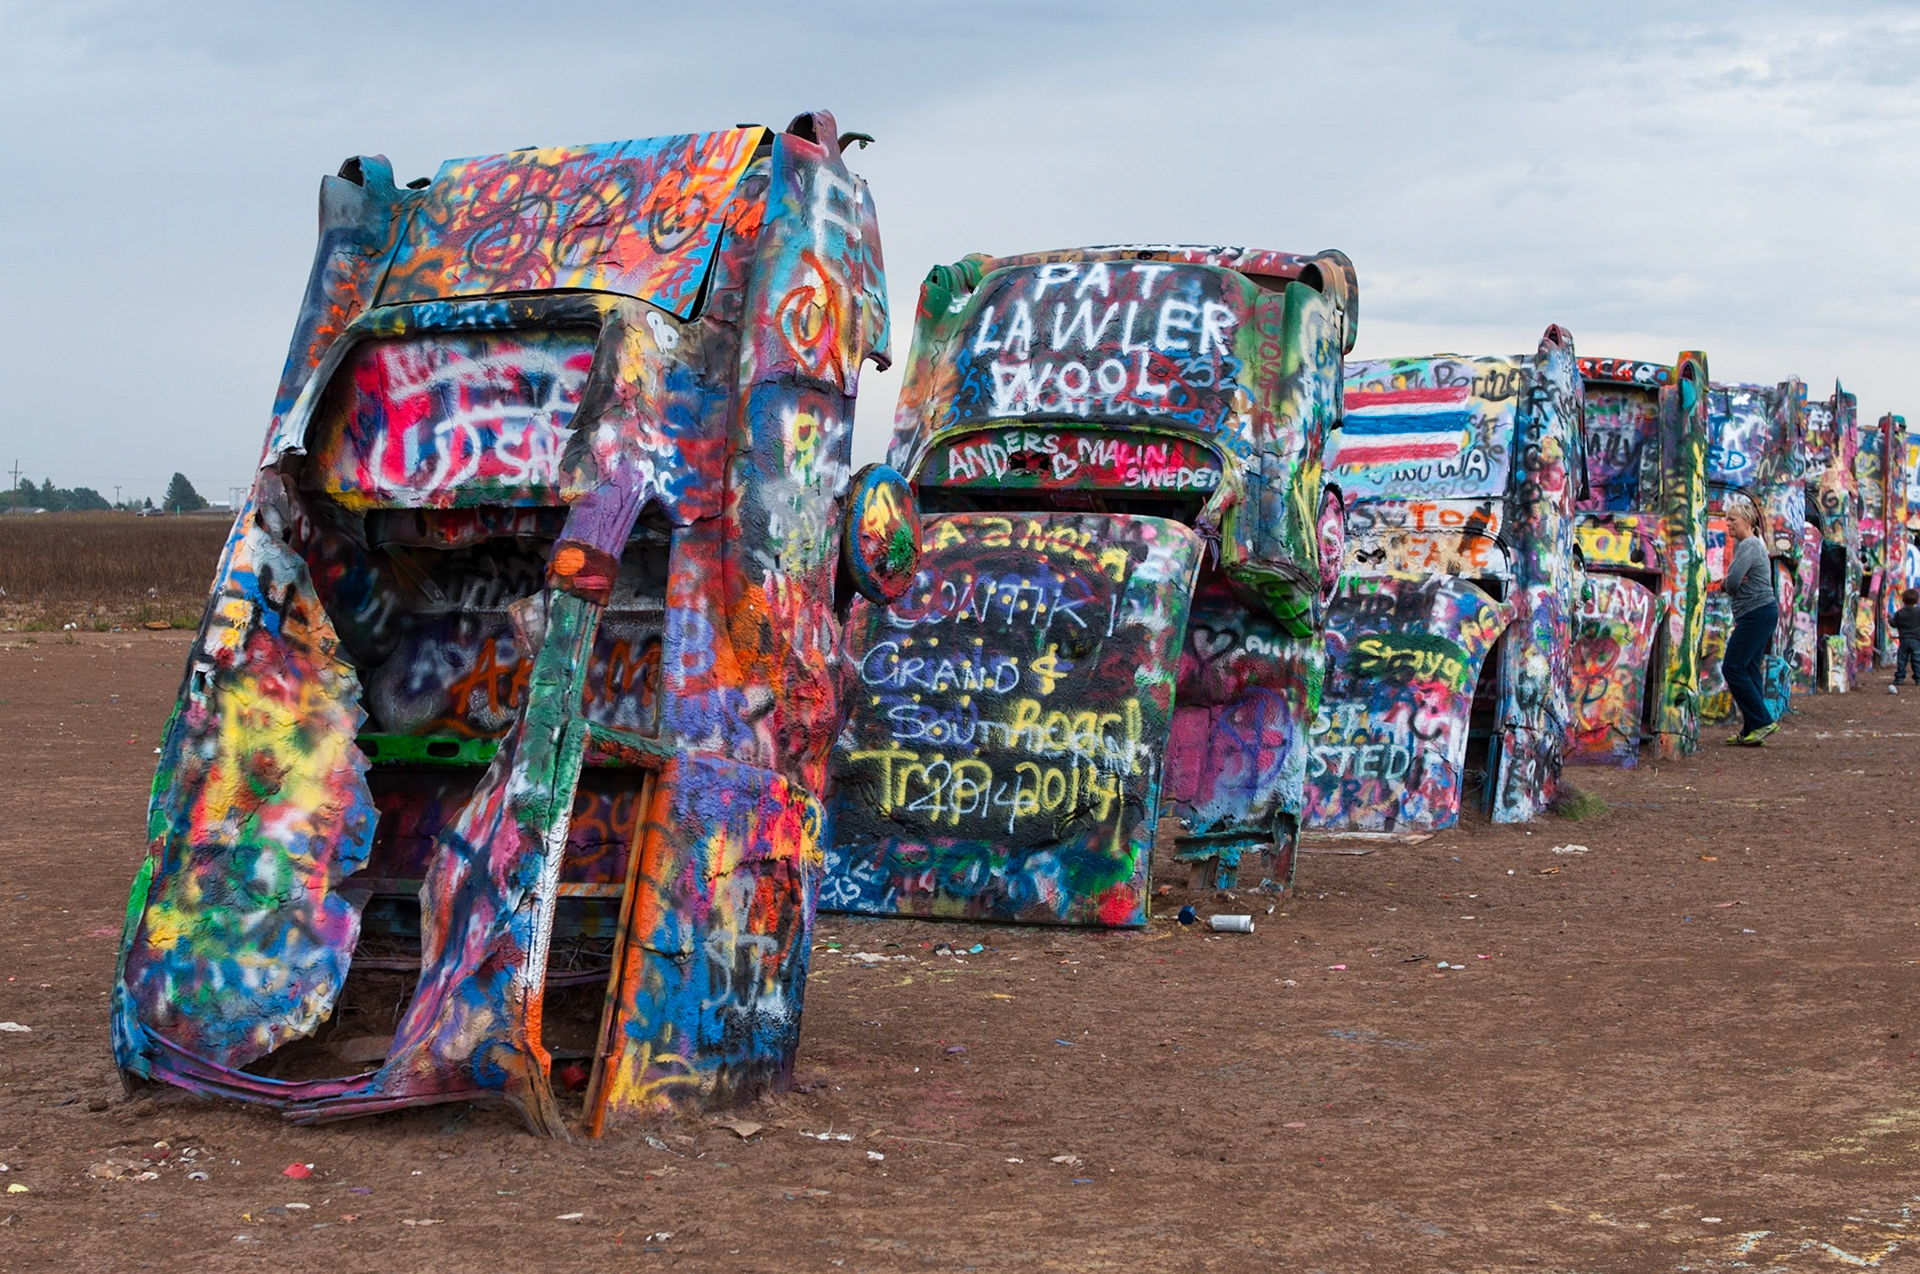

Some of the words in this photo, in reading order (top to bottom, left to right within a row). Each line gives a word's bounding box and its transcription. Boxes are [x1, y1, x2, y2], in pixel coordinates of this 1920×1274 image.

[1033, 262, 1175, 301] PAT
[974, 299, 1238, 359] LAWLER
[990, 350, 1169, 408] WOOL
[947, 432, 1060, 482] ANDERS
[1077, 437, 1168, 468] MALIN
[861, 641, 1020, 694] GRAND
[908, 759, 1036, 835] 2014
[1014, 761, 1118, 822] 2014
